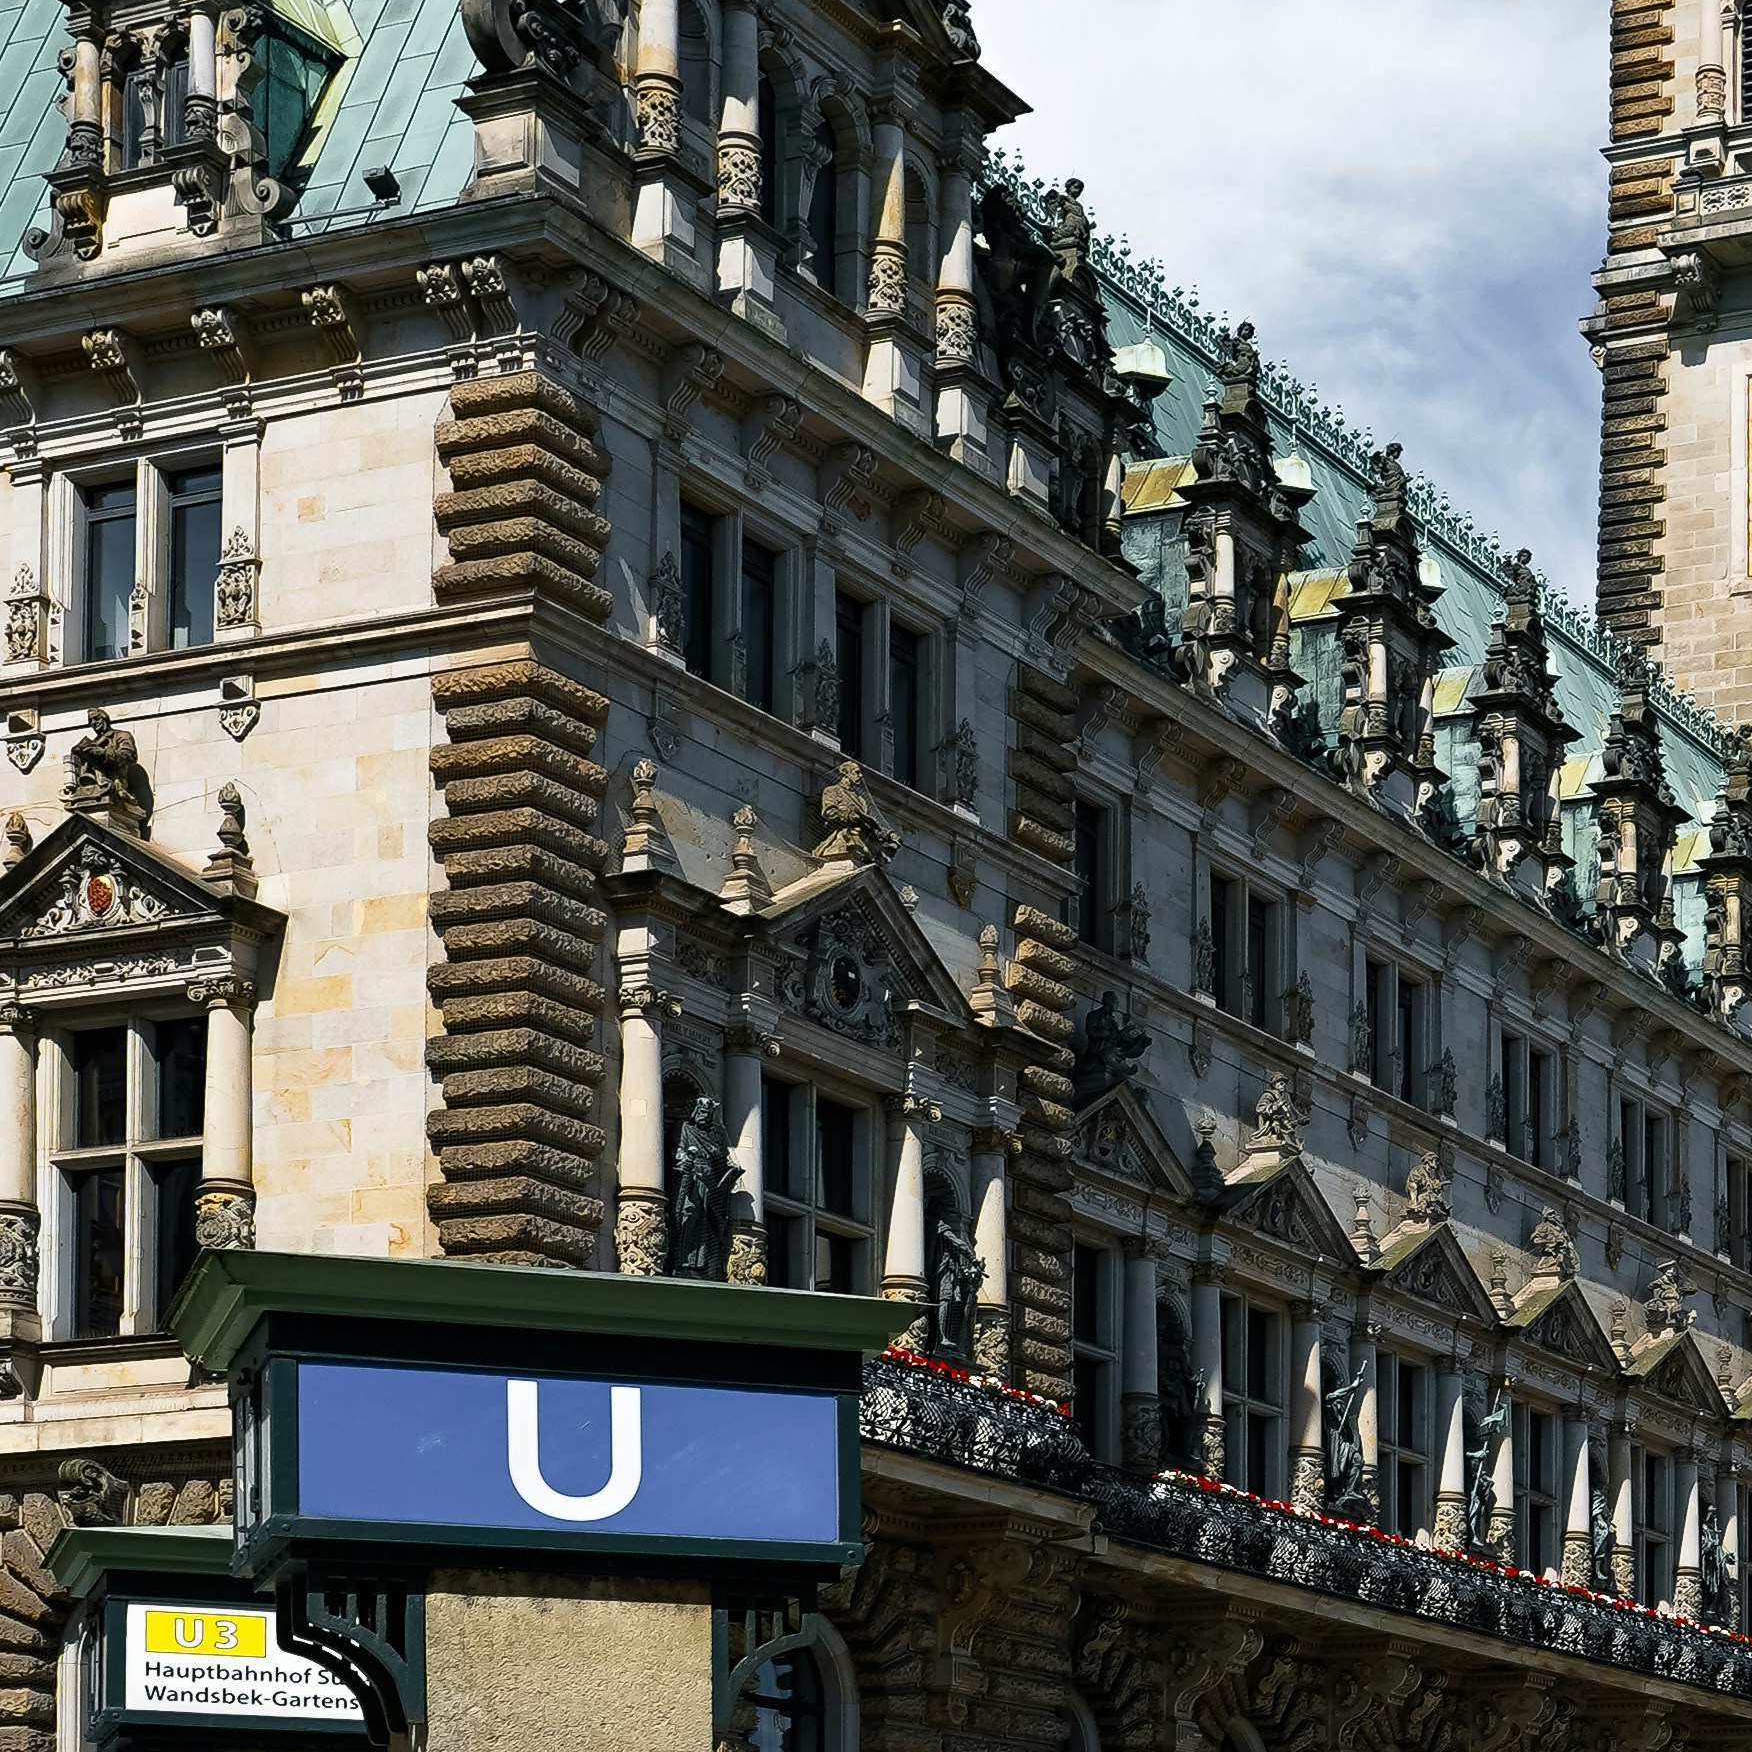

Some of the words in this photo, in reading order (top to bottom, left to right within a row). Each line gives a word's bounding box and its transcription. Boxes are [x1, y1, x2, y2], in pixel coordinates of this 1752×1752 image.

[507, 1380, 642, 1521] U
[174, 1617, 204, 1649] U
[214, 1620, 239, 1650] 3
[145, 1661, 312, 1685] Hauptbahnhof
[144, 1685, 359, 1710] Wandsbek-Gartens
